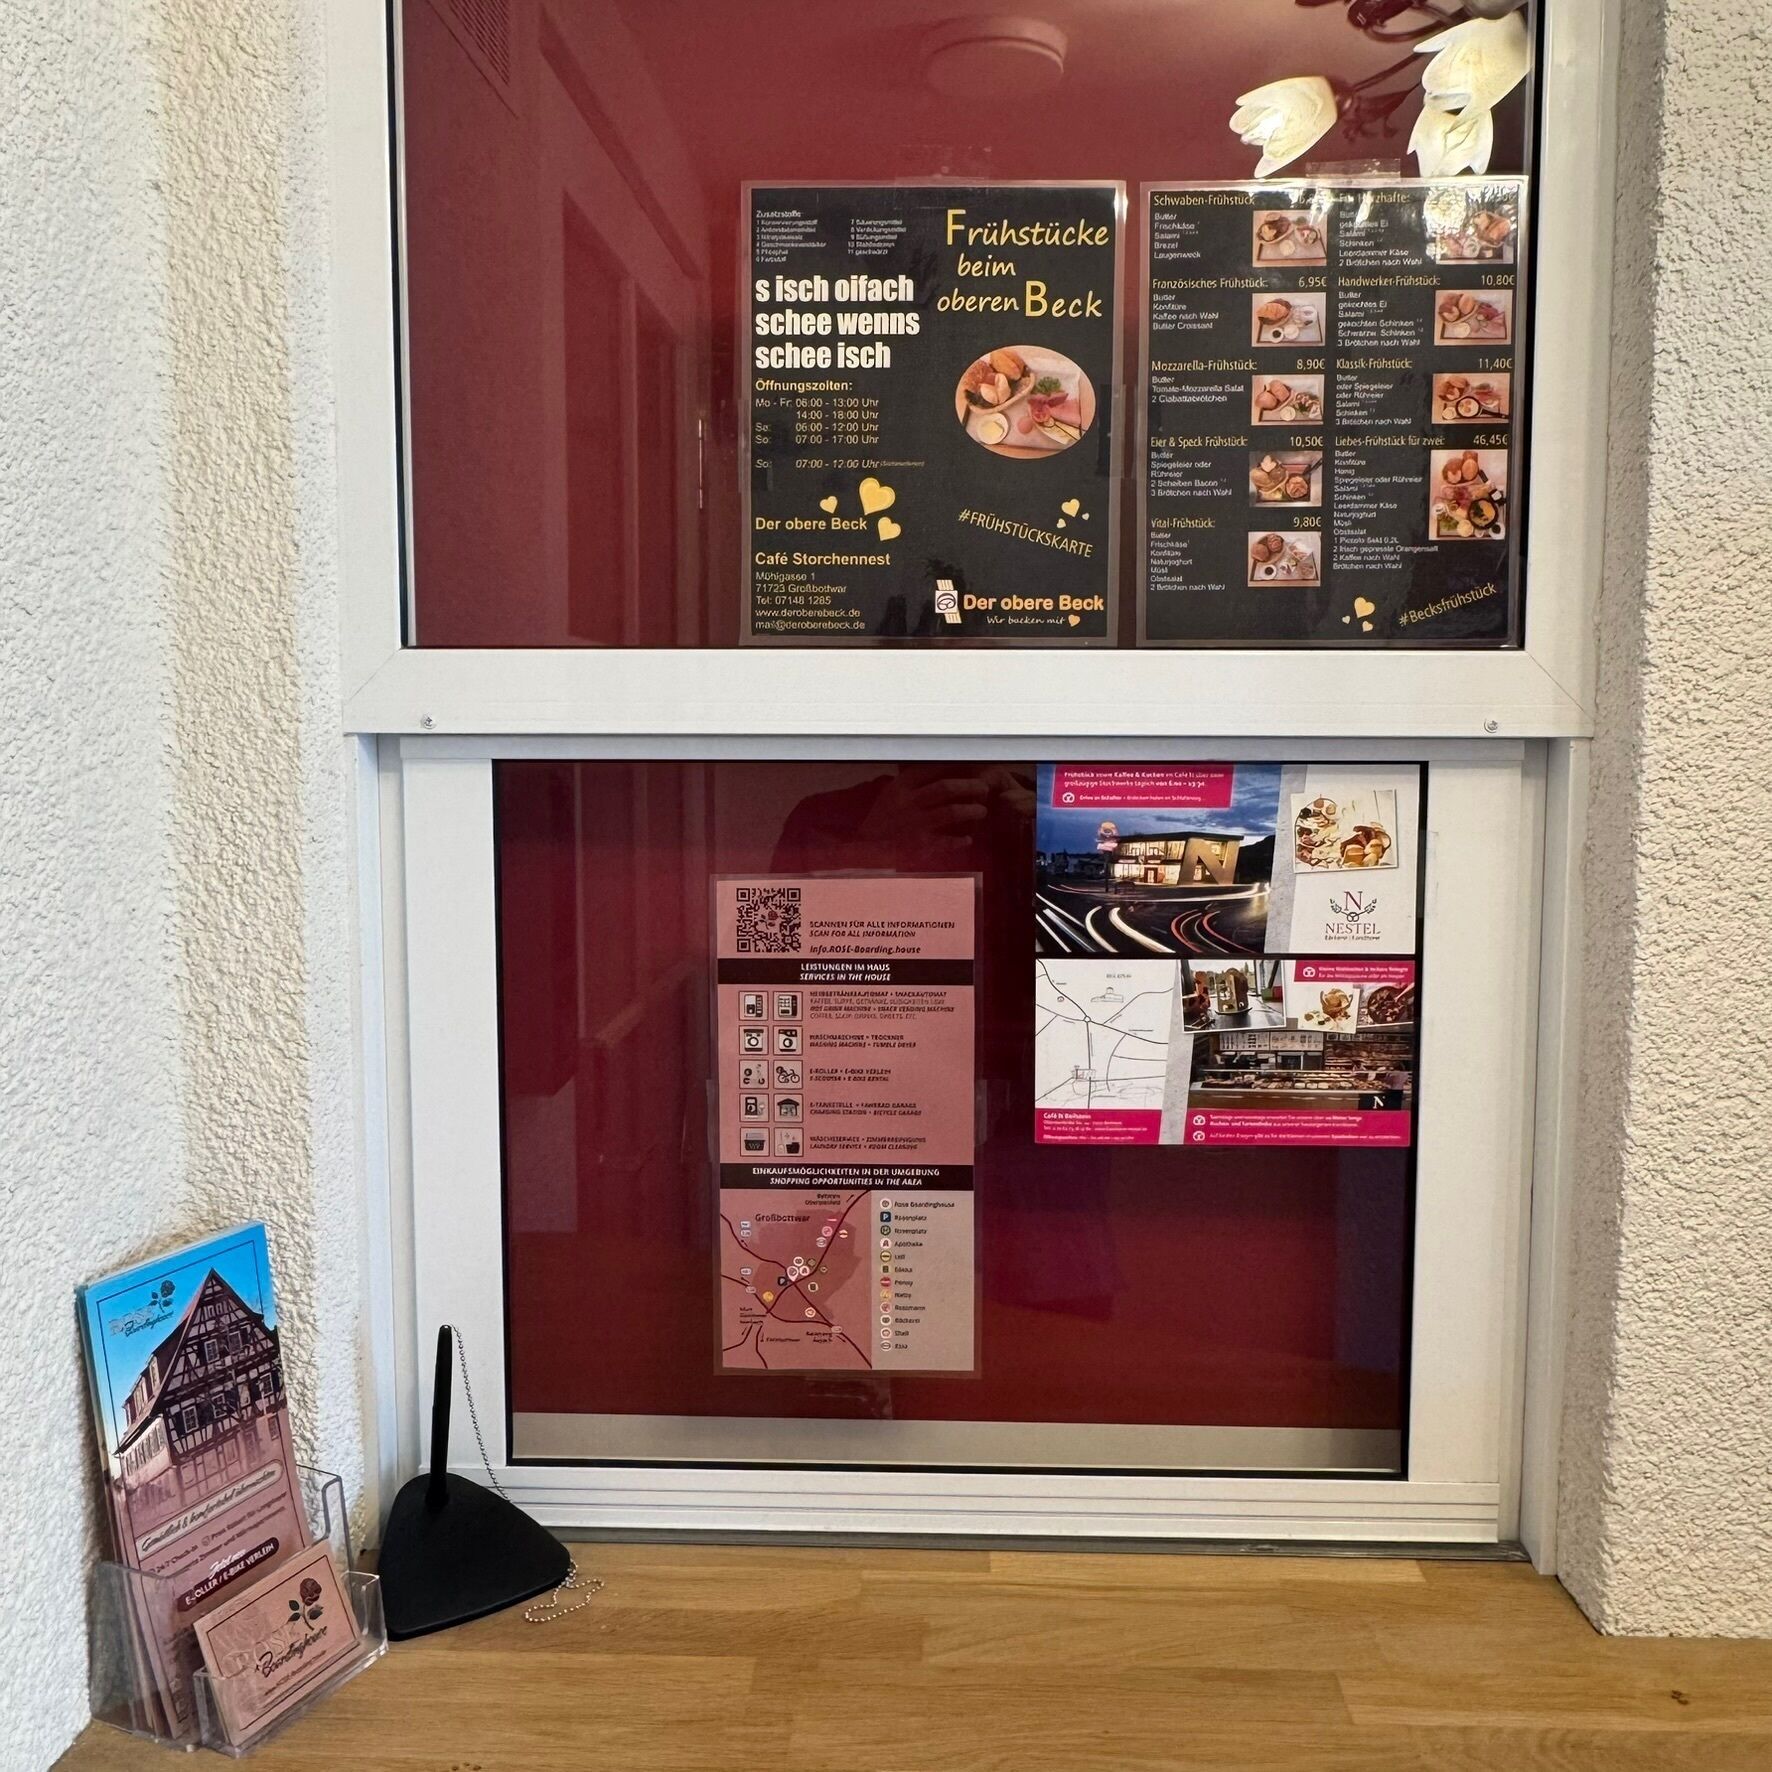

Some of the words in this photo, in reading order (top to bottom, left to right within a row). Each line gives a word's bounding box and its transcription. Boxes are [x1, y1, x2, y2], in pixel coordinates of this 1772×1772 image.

[946, 209, 1109, 246] Frühstücke
[957, 253, 1016, 276] beim
[1152, 278, 1217, 289] Französisches
[1299, 277, 1327, 288] 6,95€
[1481, 275, 1515, 286] 10,80€
[756, 280, 770, 301] s
[776, 275, 829, 301] isch
[835, 275, 914, 301] oifach
[937, 288, 1019, 312] oberen
[1025, 280, 1102, 317] Beck
[756, 309, 831, 335] schee
[837, 312, 920, 335] wenns
[756, 342, 831, 368] schee
[838, 342, 891, 368] isch
[1297, 359, 1325, 370] 8,90€
[1479, 358, 1512, 370] 11,40€
[756, 399, 770, 407] Mo
[796, 399, 822, 407] 06:00
[832, 399, 858, 407] 13:00
[862, 399, 879, 407] Uhr
[796, 411, 822, 419] 14:00
[832, 411, 858, 419] 18:00
[862, 411, 879, 419] Uhr
[796, 423, 822, 431] 06:00
[862, 423, 879, 431] Uhr
[796, 435, 822, 443] 07:00
[832, 435, 858, 443] 17:00
[862, 435, 879, 443] Uhr
[1169, 438, 1175, 446] &
[1178, 437, 1202, 448] Speck
[1290, 437, 1323, 448] 10,50€
[1336, 435, 1406, 446] Liebes-Frühstück
[1408, 435, 1420, 446] für
[1473, 435, 1508, 446] 46,45€
[796, 460, 822, 468] 07:00
[862, 460, 879, 468] Uhr
[755, 518, 781, 530] Der
[785, 518, 826, 530] obere
[831, 518, 867, 530] Beck
[1294, 517, 1321, 528] 9,80€
[958, 509, 1093, 558] #FRÜHSTÜCKSKARTE
[755, 552, 788, 565] Café
[793, 552, 890, 565] Storchennest
[756, 584, 785, 593] 71723
[775, 596, 804, 604] 07148
[809, 596, 831, 604] 1285
[963, 594, 997, 610] Der
[1000, 594, 1053, 610] obere
[1059, 594, 1104, 610] Beck
[1399, 582, 1496, 627] #Becksfrühstück
[755, 609, 860, 618] www.deroberebeck.de
[987, 616, 1005, 624] Wir
[1008, 616, 1044, 624] backen
[1047, 616, 1066, 624] mit
[1344, 891, 1362, 911] N
[867, 920, 885, 929] ALLE
[1325, 923, 1381, 934] NESTEL
[801, 963, 852, 971] LEISTUNGEN
[854, 963, 865, 971] IM
[867, 963, 890, 971] HAUS
[800, 973, 835, 981] SERVICES
[837, 973, 847, 981] IN
[849, 973, 862, 981] THE
[865, 973, 891, 981] HOUSE
[862, 1167, 871, 1176] IN
[873, 1167, 889, 1176] DER
[891, 1167, 940, 1176] UMGEBUNG
[770, 1177, 810, 1186] SHOPPING
[812, 1177, 872, 1186] OPPORTUNITIES
[875, 1177, 884, 1186] IN
[886, 1177, 900, 1186] THE
[902, 1177, 922, 1186] AREA
[186, 1575, 218, 1605] E-OLLER
[223, 1561, 245, 1581] E-BIKE
[246, 1543, 274, 1565] VERLEIH
